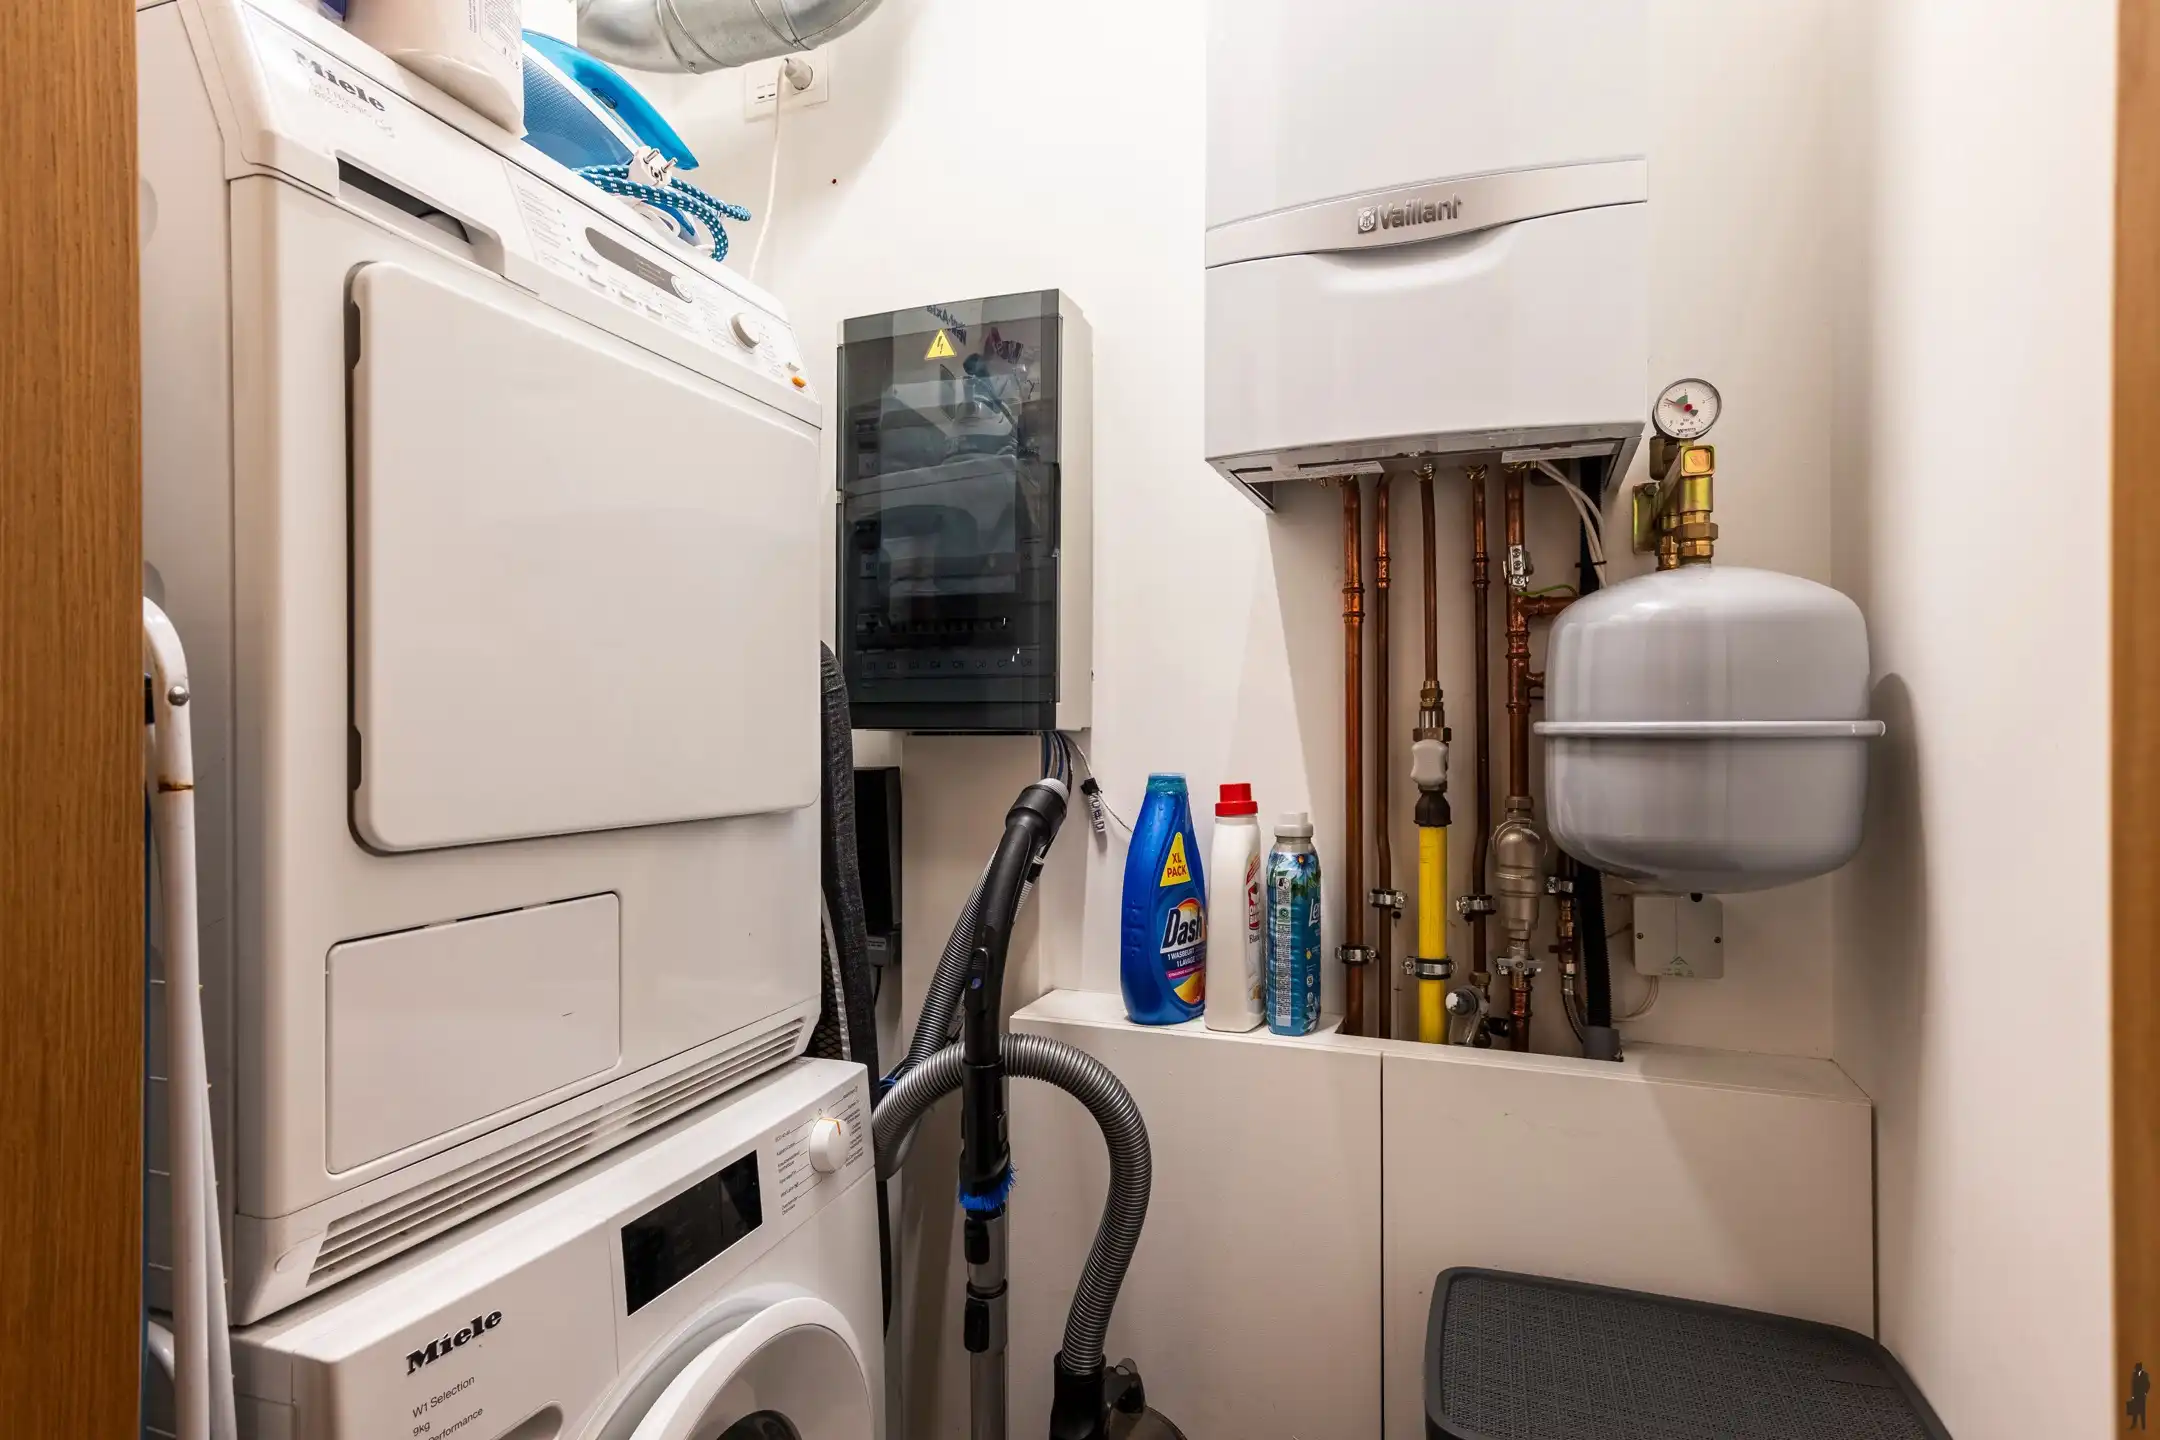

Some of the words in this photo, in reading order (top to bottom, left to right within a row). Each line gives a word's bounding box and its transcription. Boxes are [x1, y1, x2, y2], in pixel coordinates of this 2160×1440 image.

[292, 48, 386, 112] Miele
[1377, 193, 1462, 230] Vaillant
[1166, 864, 1187, 878] PACK
[1171, 852, 1182, 864] XL
[1162, 907, 1203, 949] Dash
[405, 1310, 503, 1376] Miele
[412, 1402, 429, 1418] W1
[430, 1376, 475, 1408] Selection
